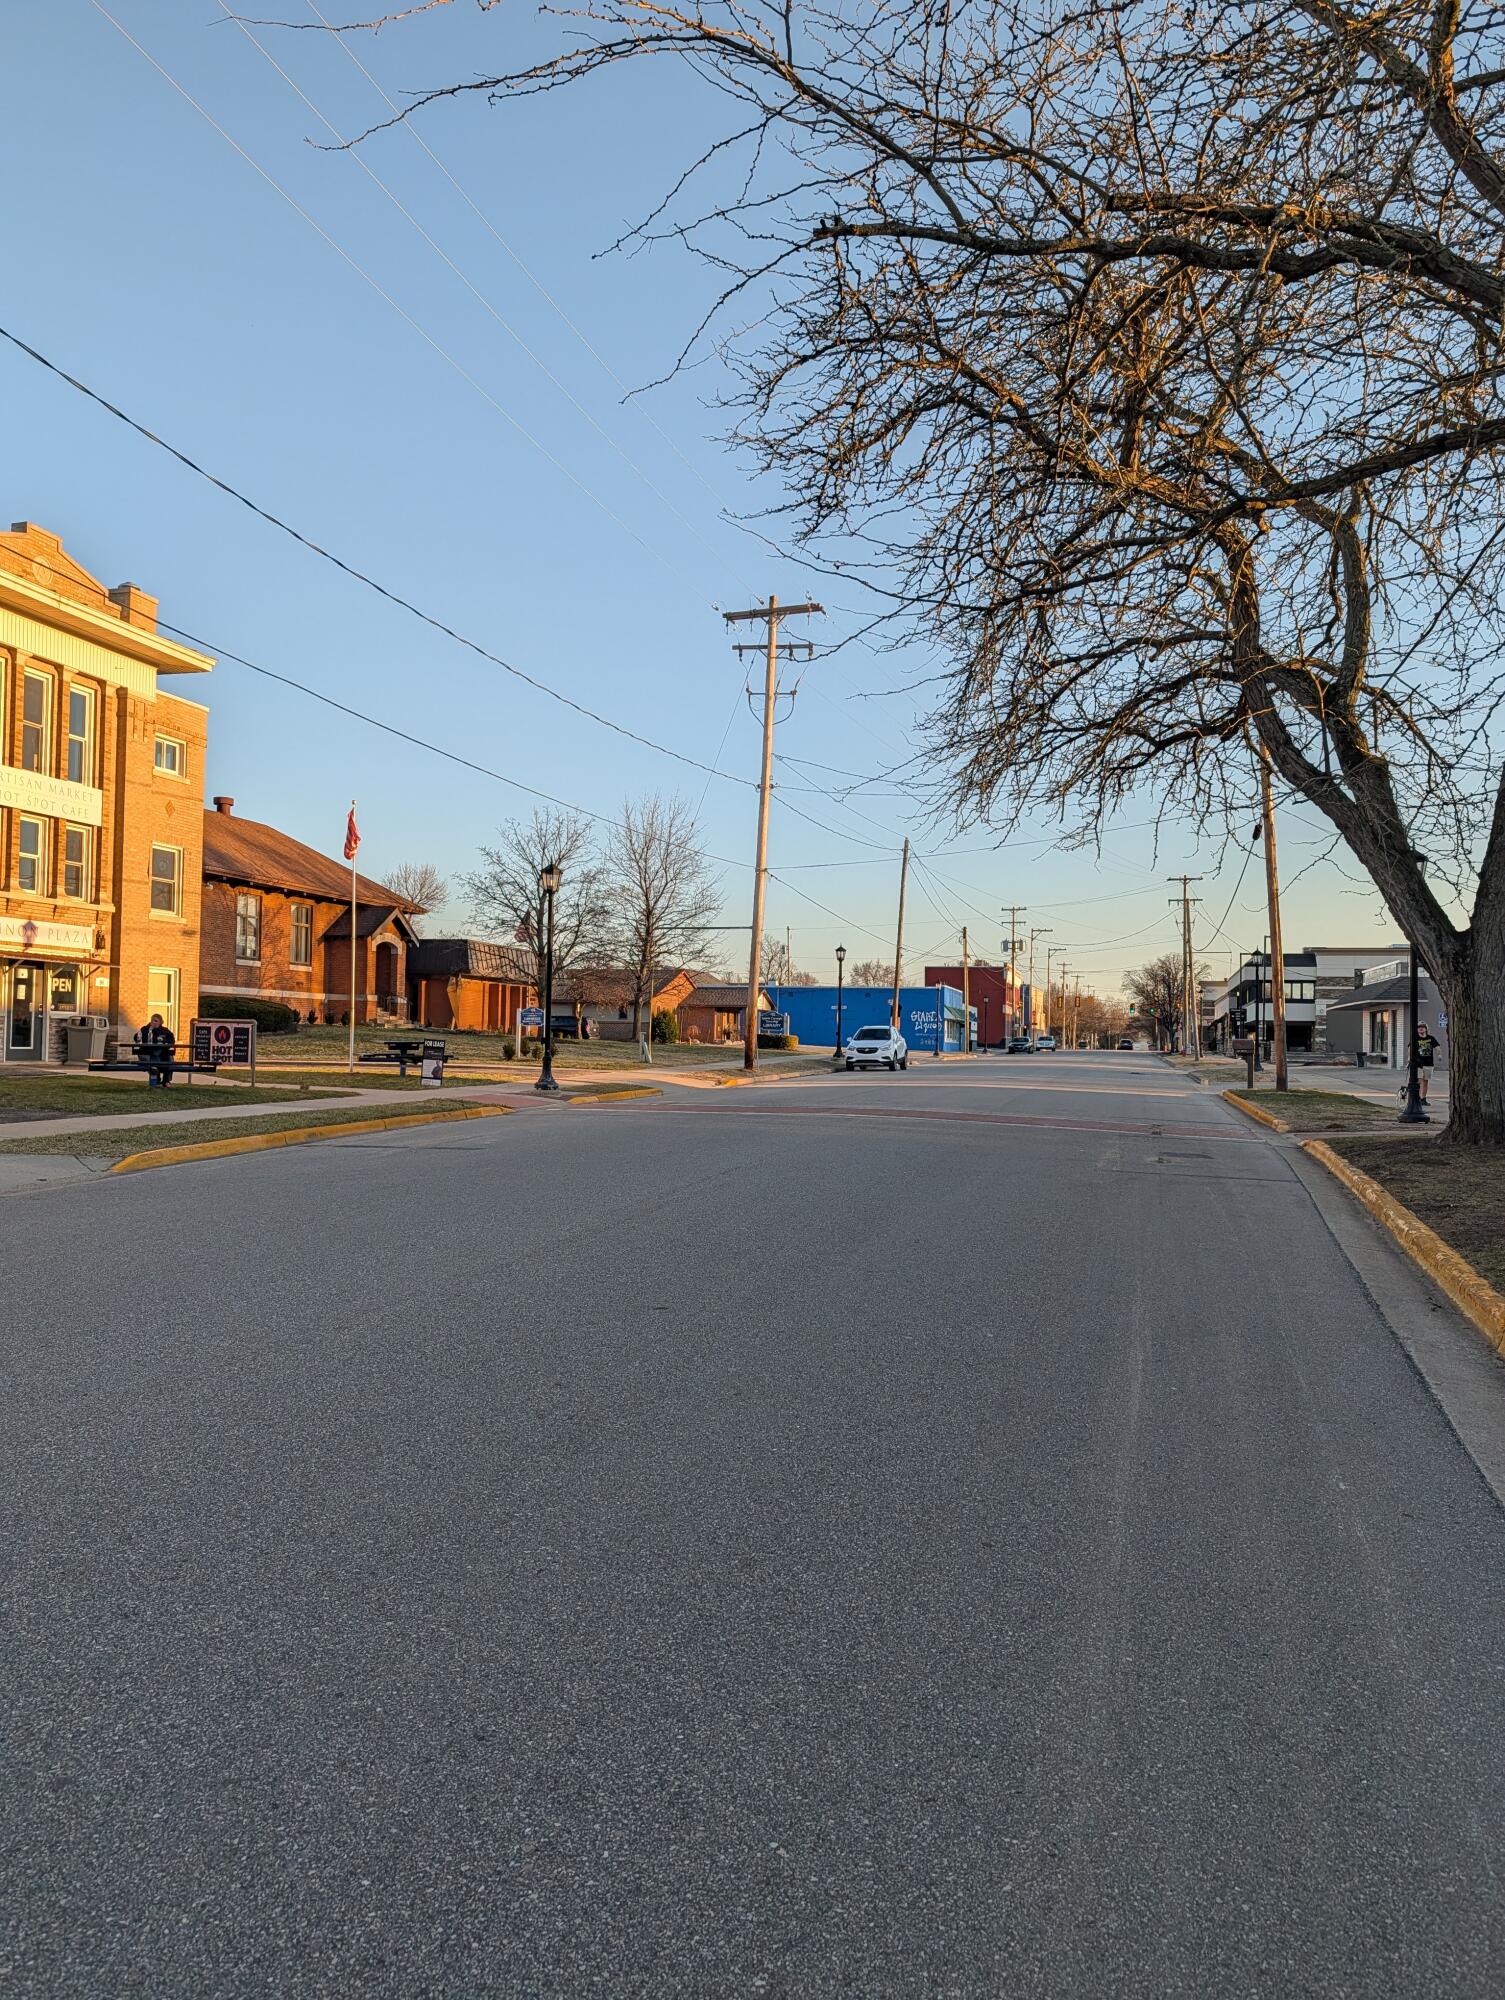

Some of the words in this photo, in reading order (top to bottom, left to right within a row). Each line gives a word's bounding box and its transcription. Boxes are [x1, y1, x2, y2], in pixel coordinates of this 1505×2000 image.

[49, 783, 95, 803] MARKET
[0, 790, 20, 803] OT
[27, 796, 56, 811] SPOT
[61, 802, 89, 819] CAFE
[0, 923, 39, 938] NON
[48, 930, 88, 943] PLAZA
[53, 978, 72, 992] PEN
[212, 1046, 232, 1055] HOT
[212, 1055, 232, 1063] SPOT
